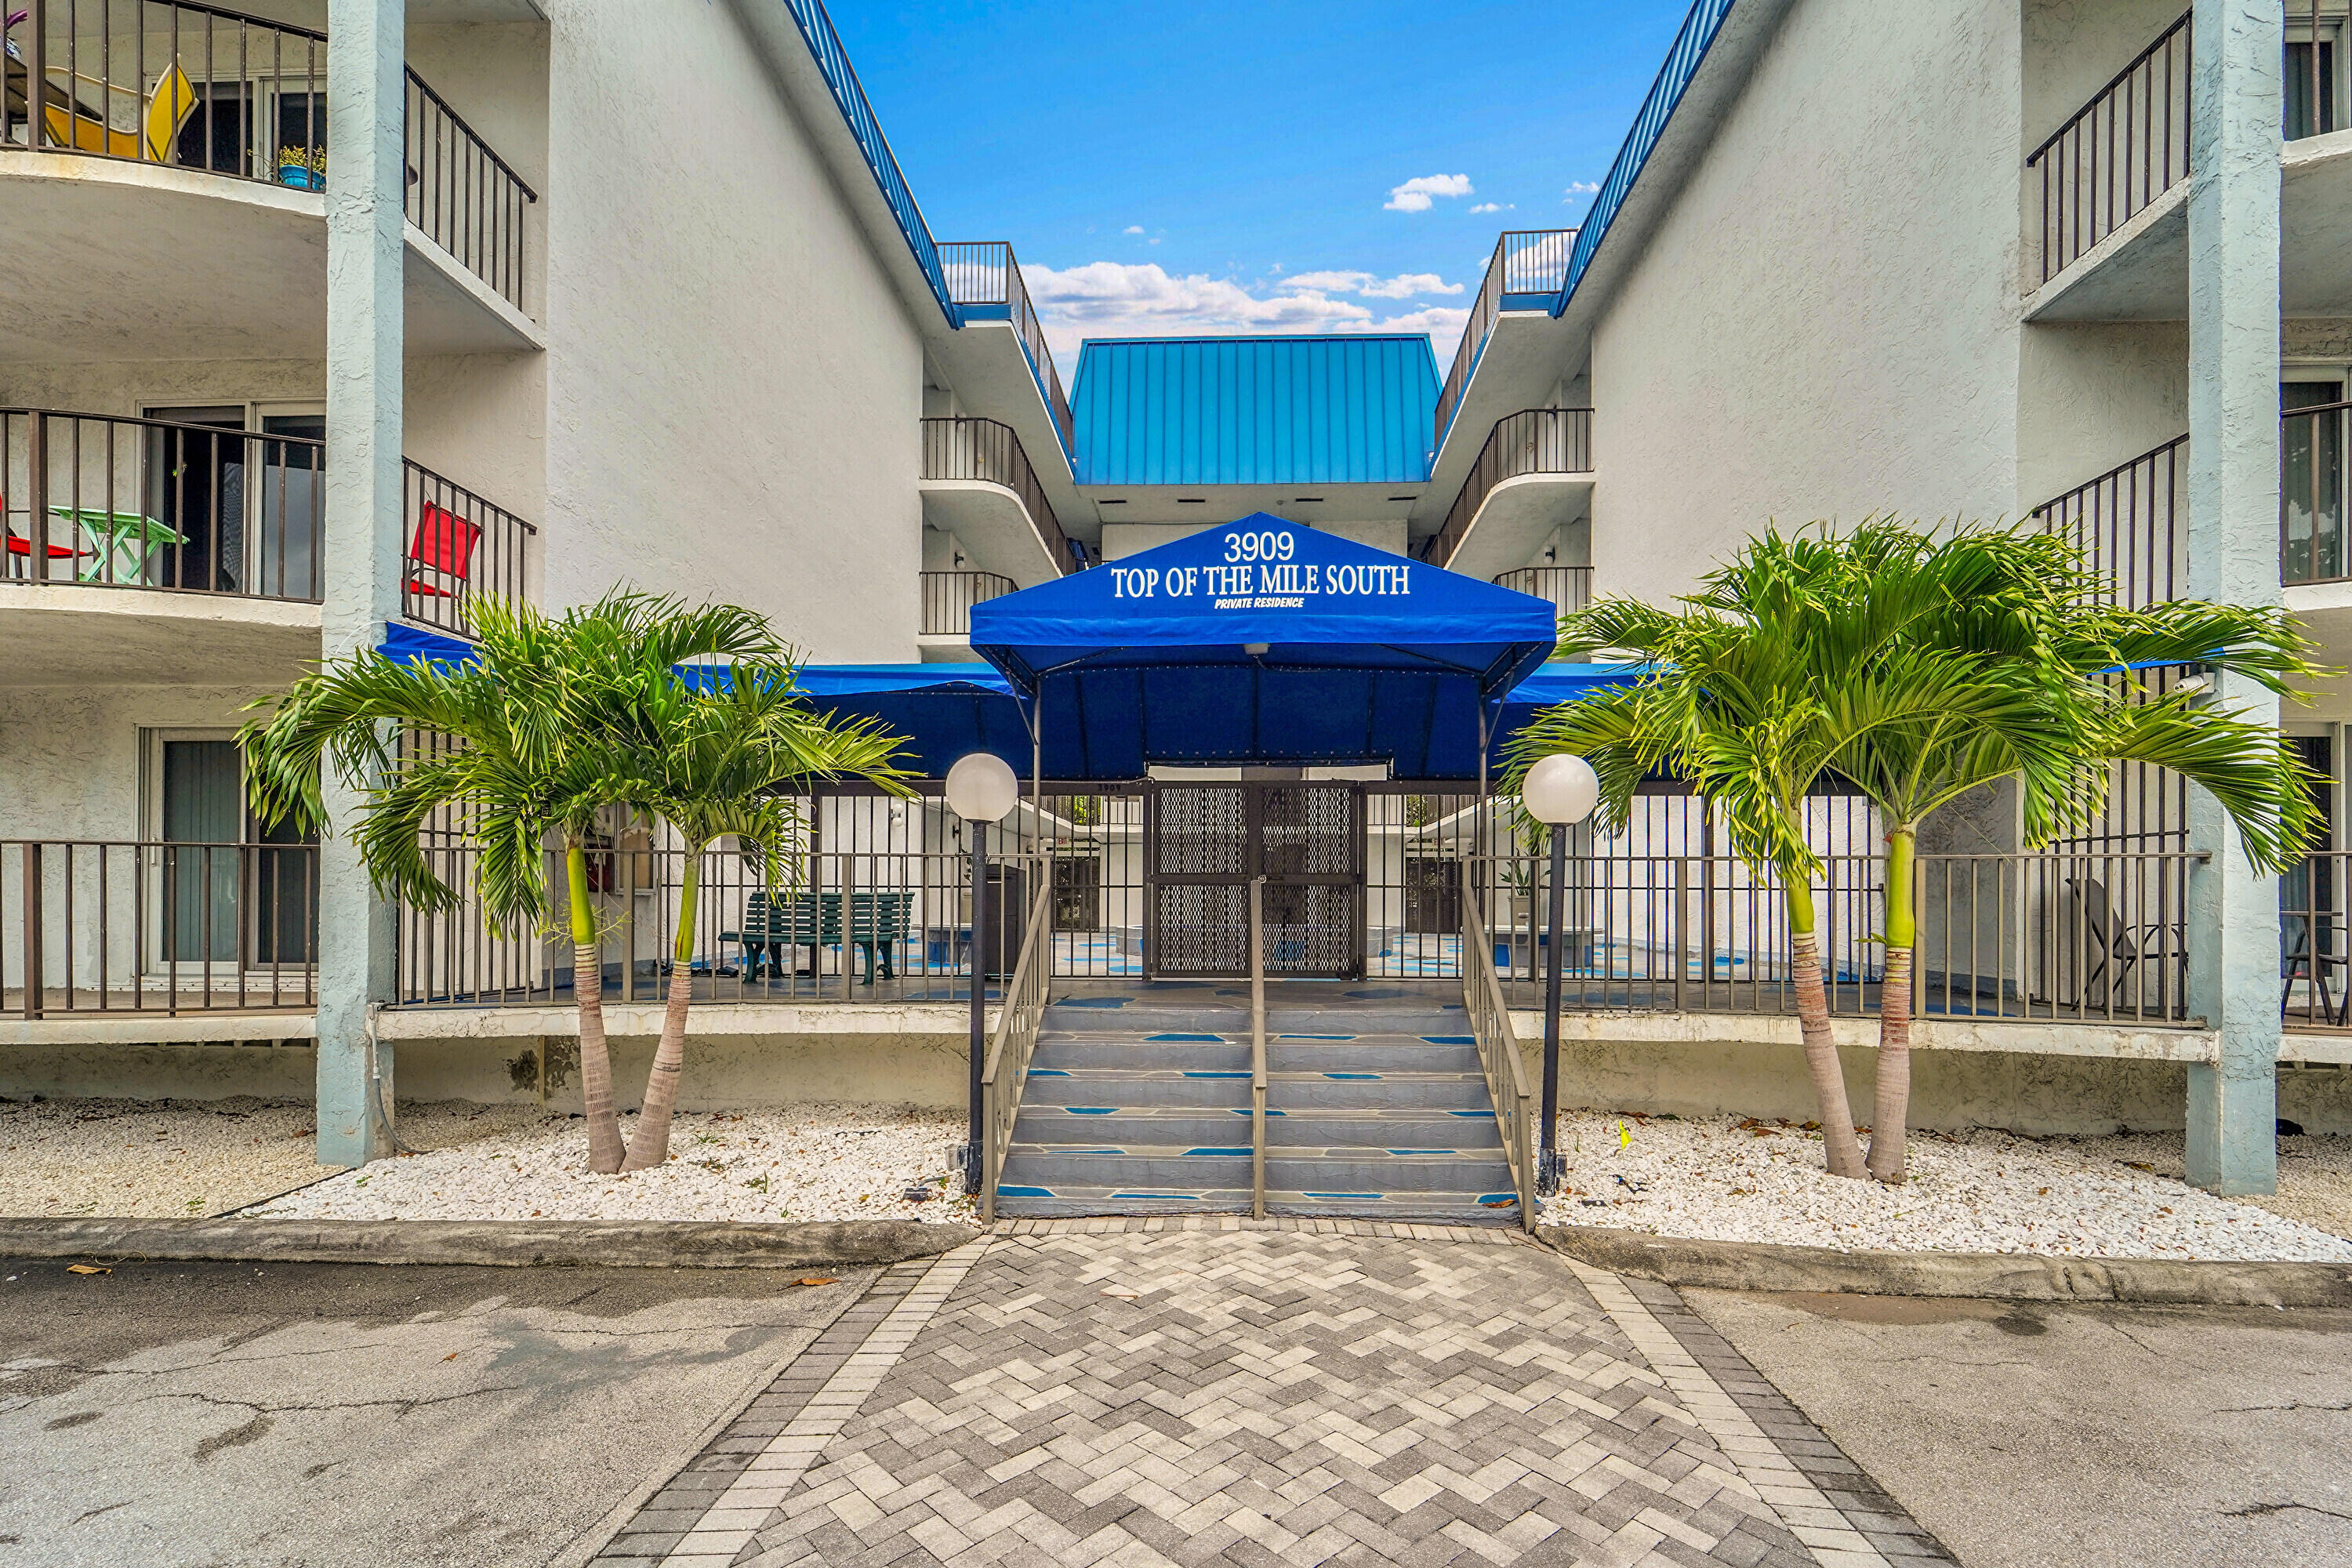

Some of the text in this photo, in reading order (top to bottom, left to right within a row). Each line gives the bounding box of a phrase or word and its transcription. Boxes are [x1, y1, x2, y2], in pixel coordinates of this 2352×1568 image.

[1224, 532, 1294, 562] 3909
[1111, 564, 1410, 598] TOP OF THE MILE SOUTH
[1214, 597, 1305, 609] PRIVATE RESIDENCE
